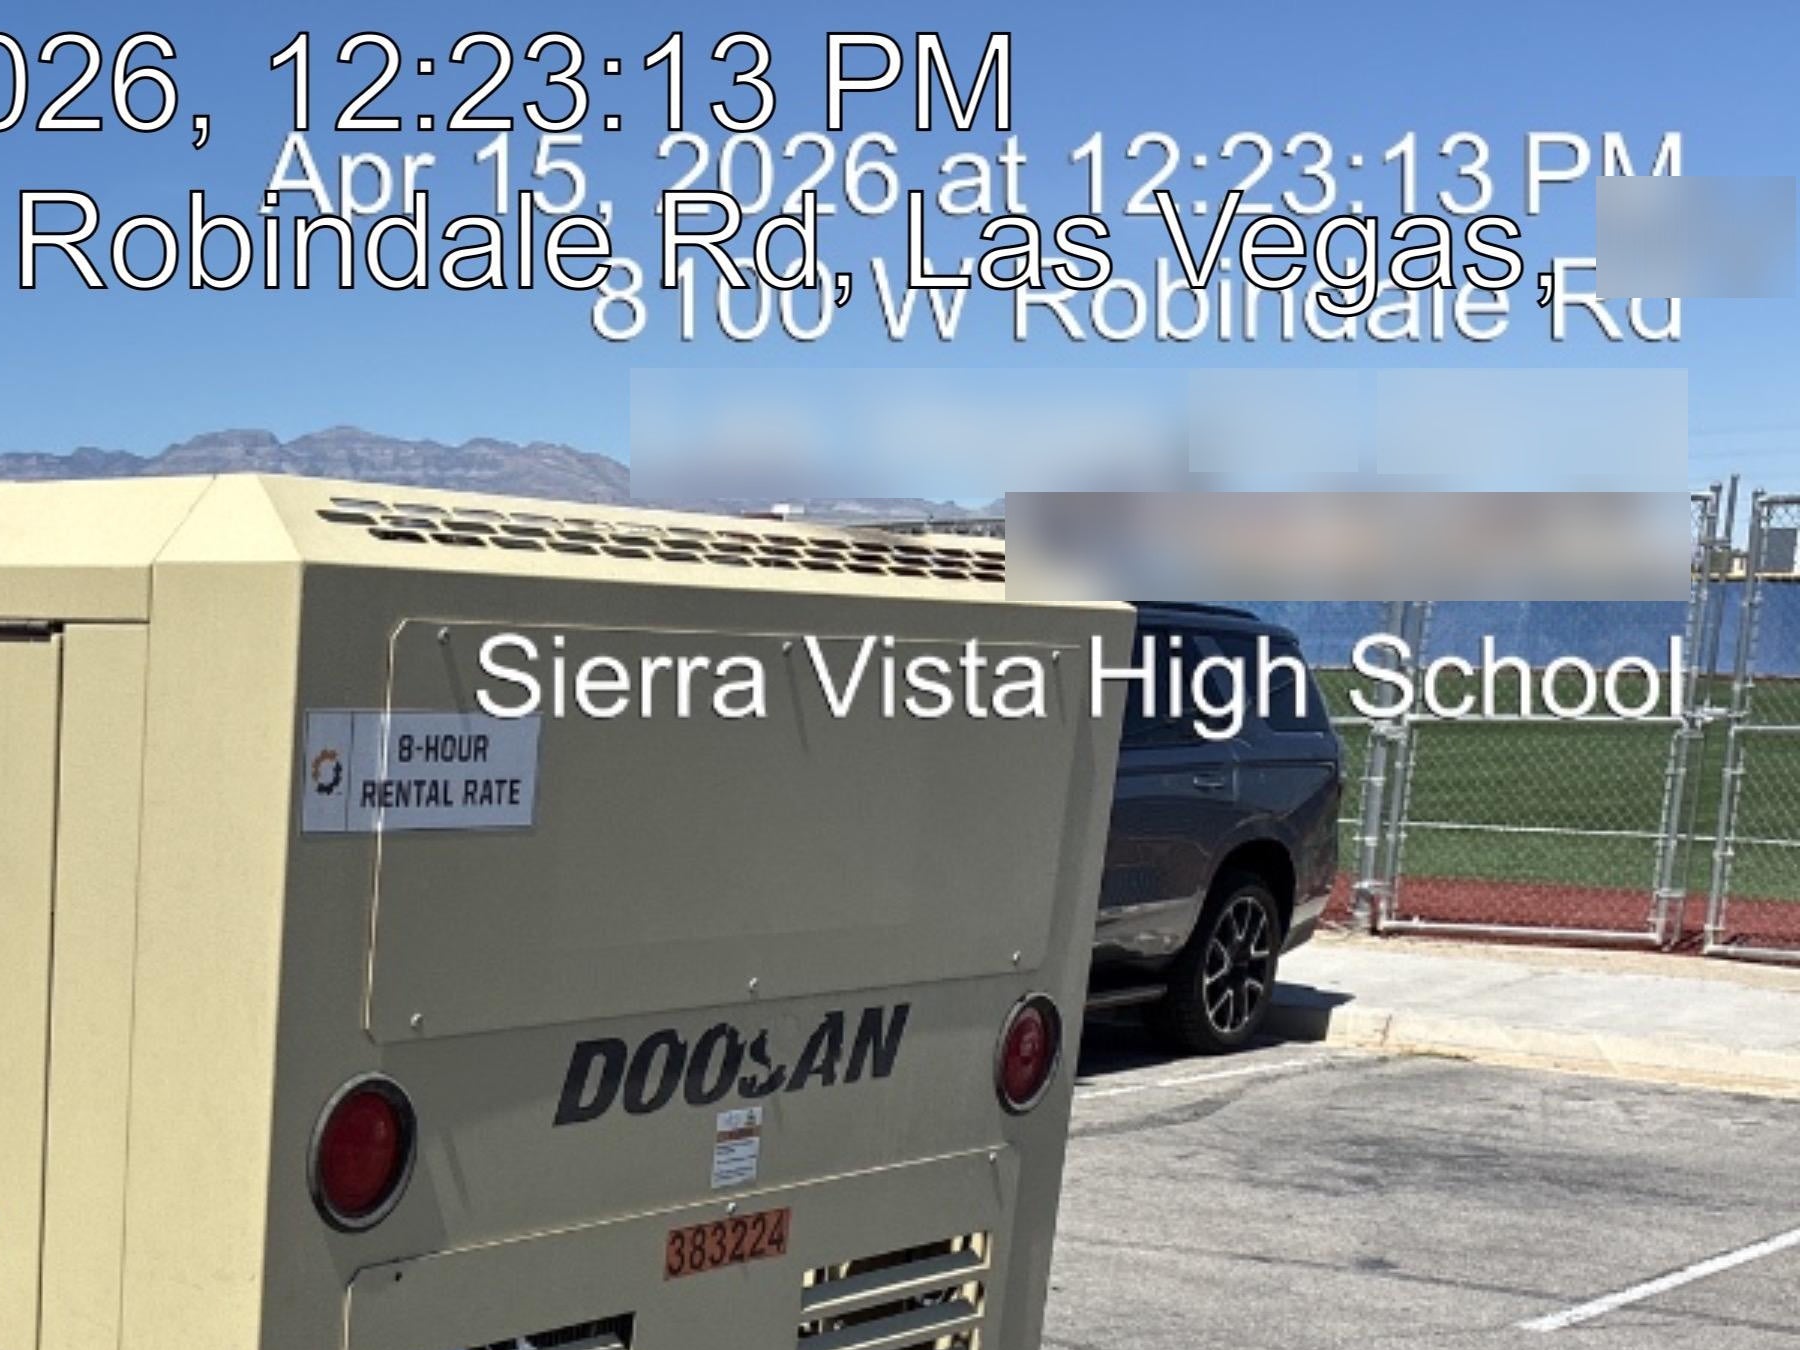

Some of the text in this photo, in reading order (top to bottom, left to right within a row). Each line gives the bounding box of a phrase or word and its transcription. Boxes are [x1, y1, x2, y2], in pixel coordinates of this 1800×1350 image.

[397, 733, 490, 763] 8-HOUR
[359, 778, 523, 808] RENTAL RATE
[552, 1002, 911, 1127] DOOSAN
[668, 1208, 788, 1277] 383224
